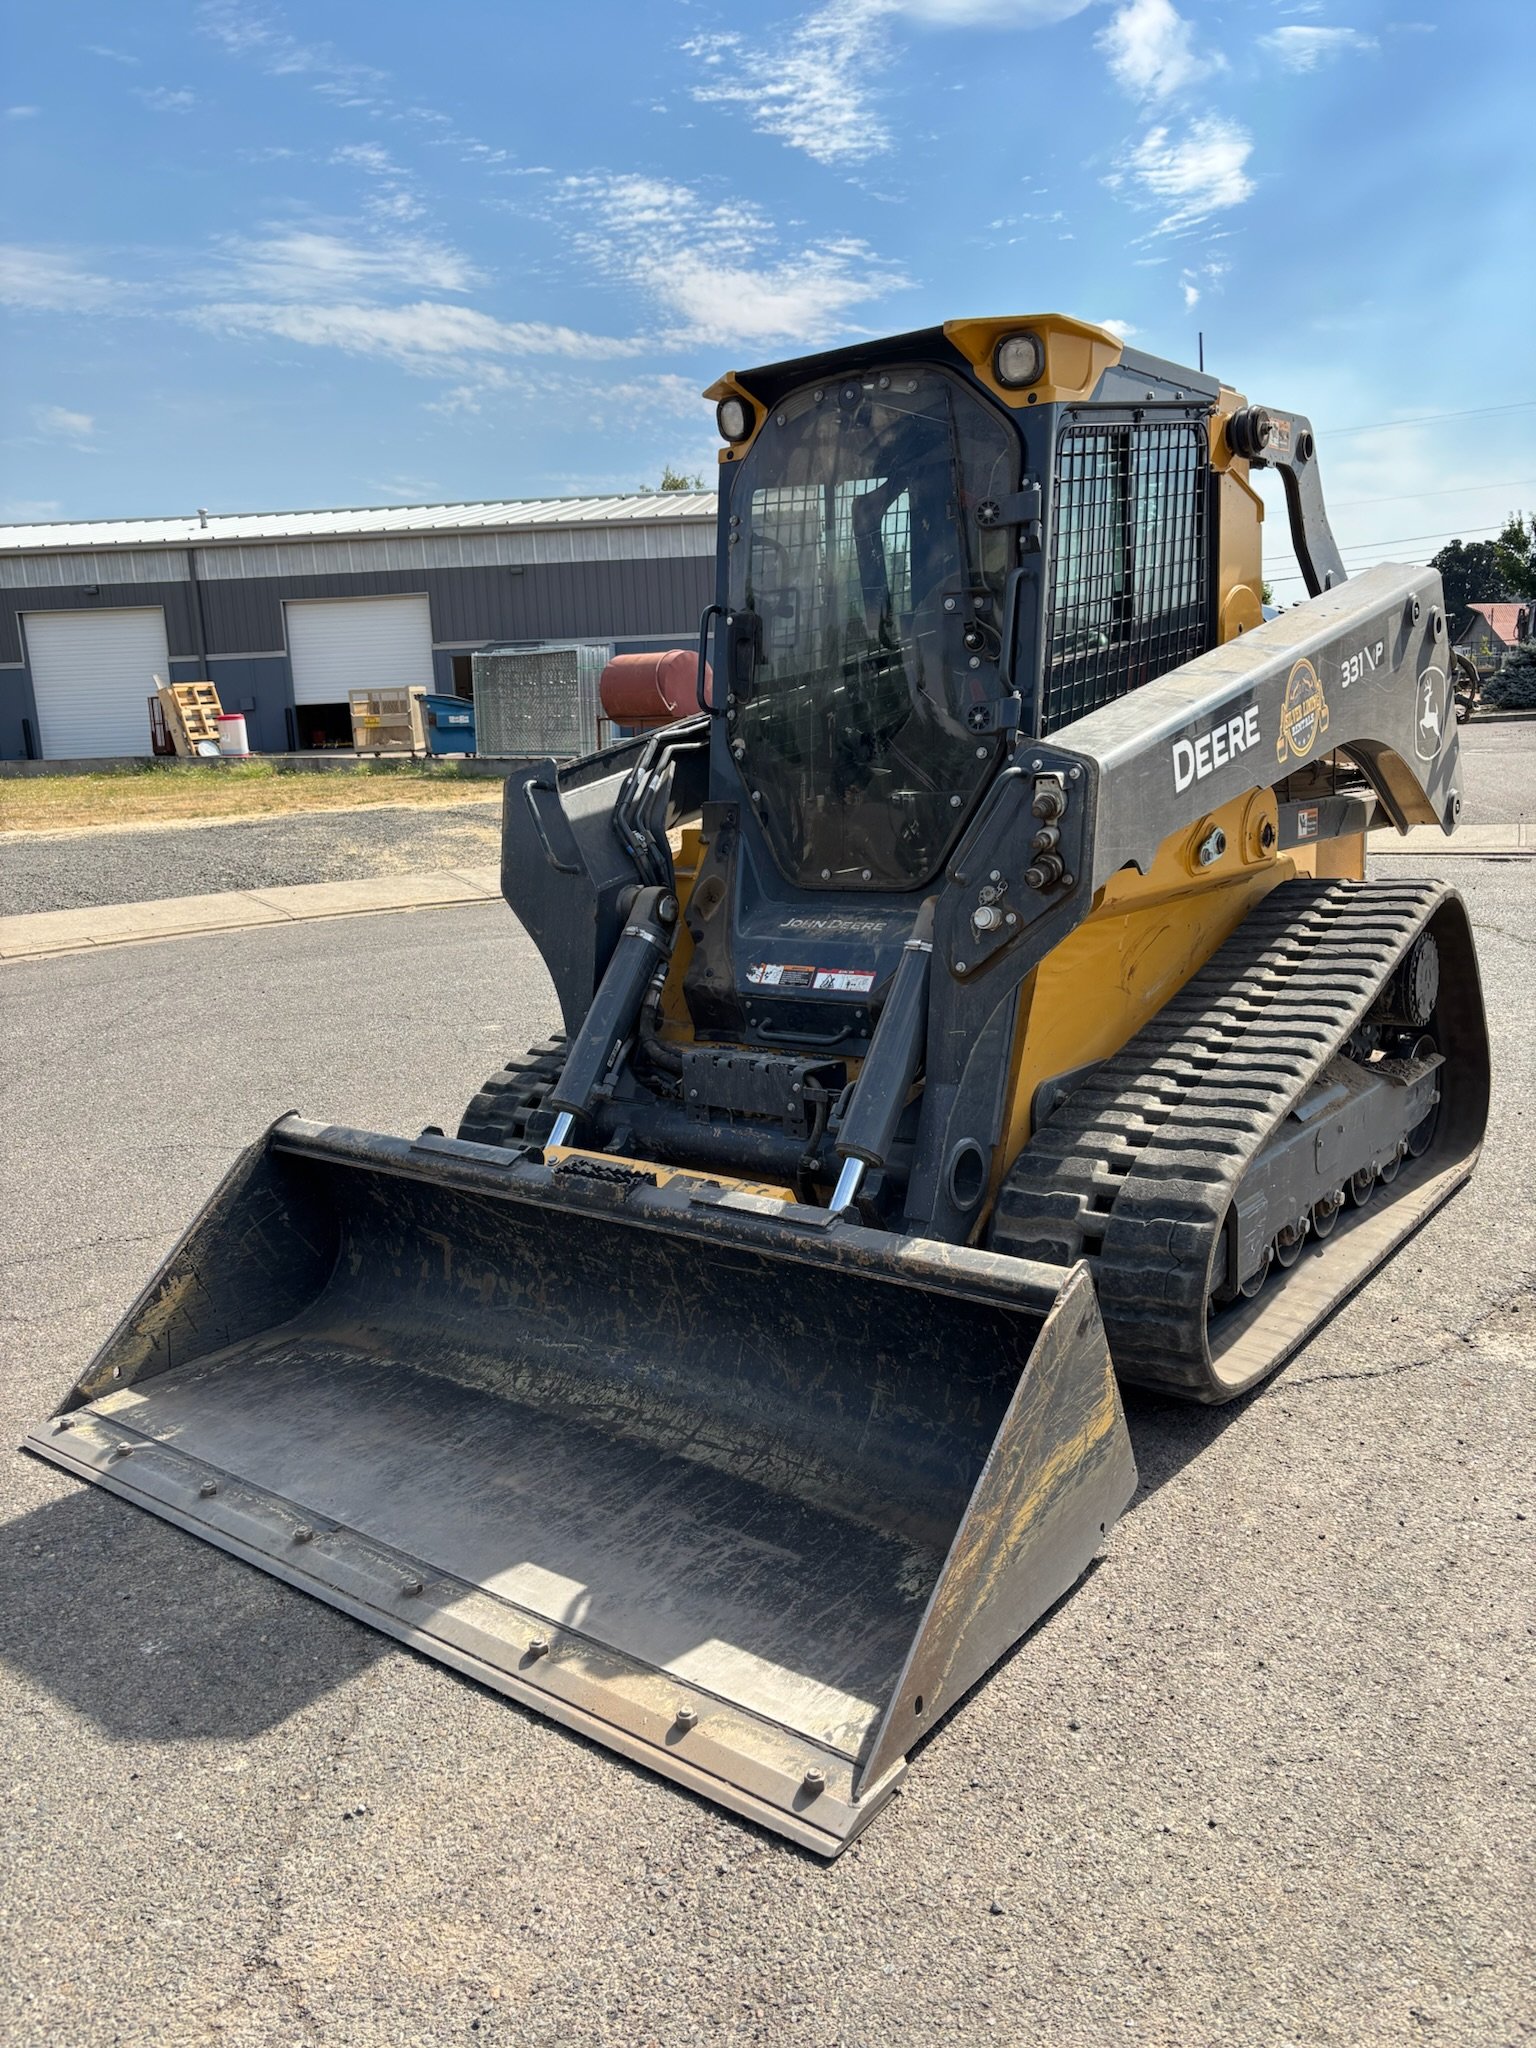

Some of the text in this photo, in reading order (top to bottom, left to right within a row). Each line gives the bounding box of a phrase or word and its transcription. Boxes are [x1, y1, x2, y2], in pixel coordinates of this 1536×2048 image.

[1172, 705, 1261, 794] DEERE
[780, 918, 888, 931] JOHN DEERE
